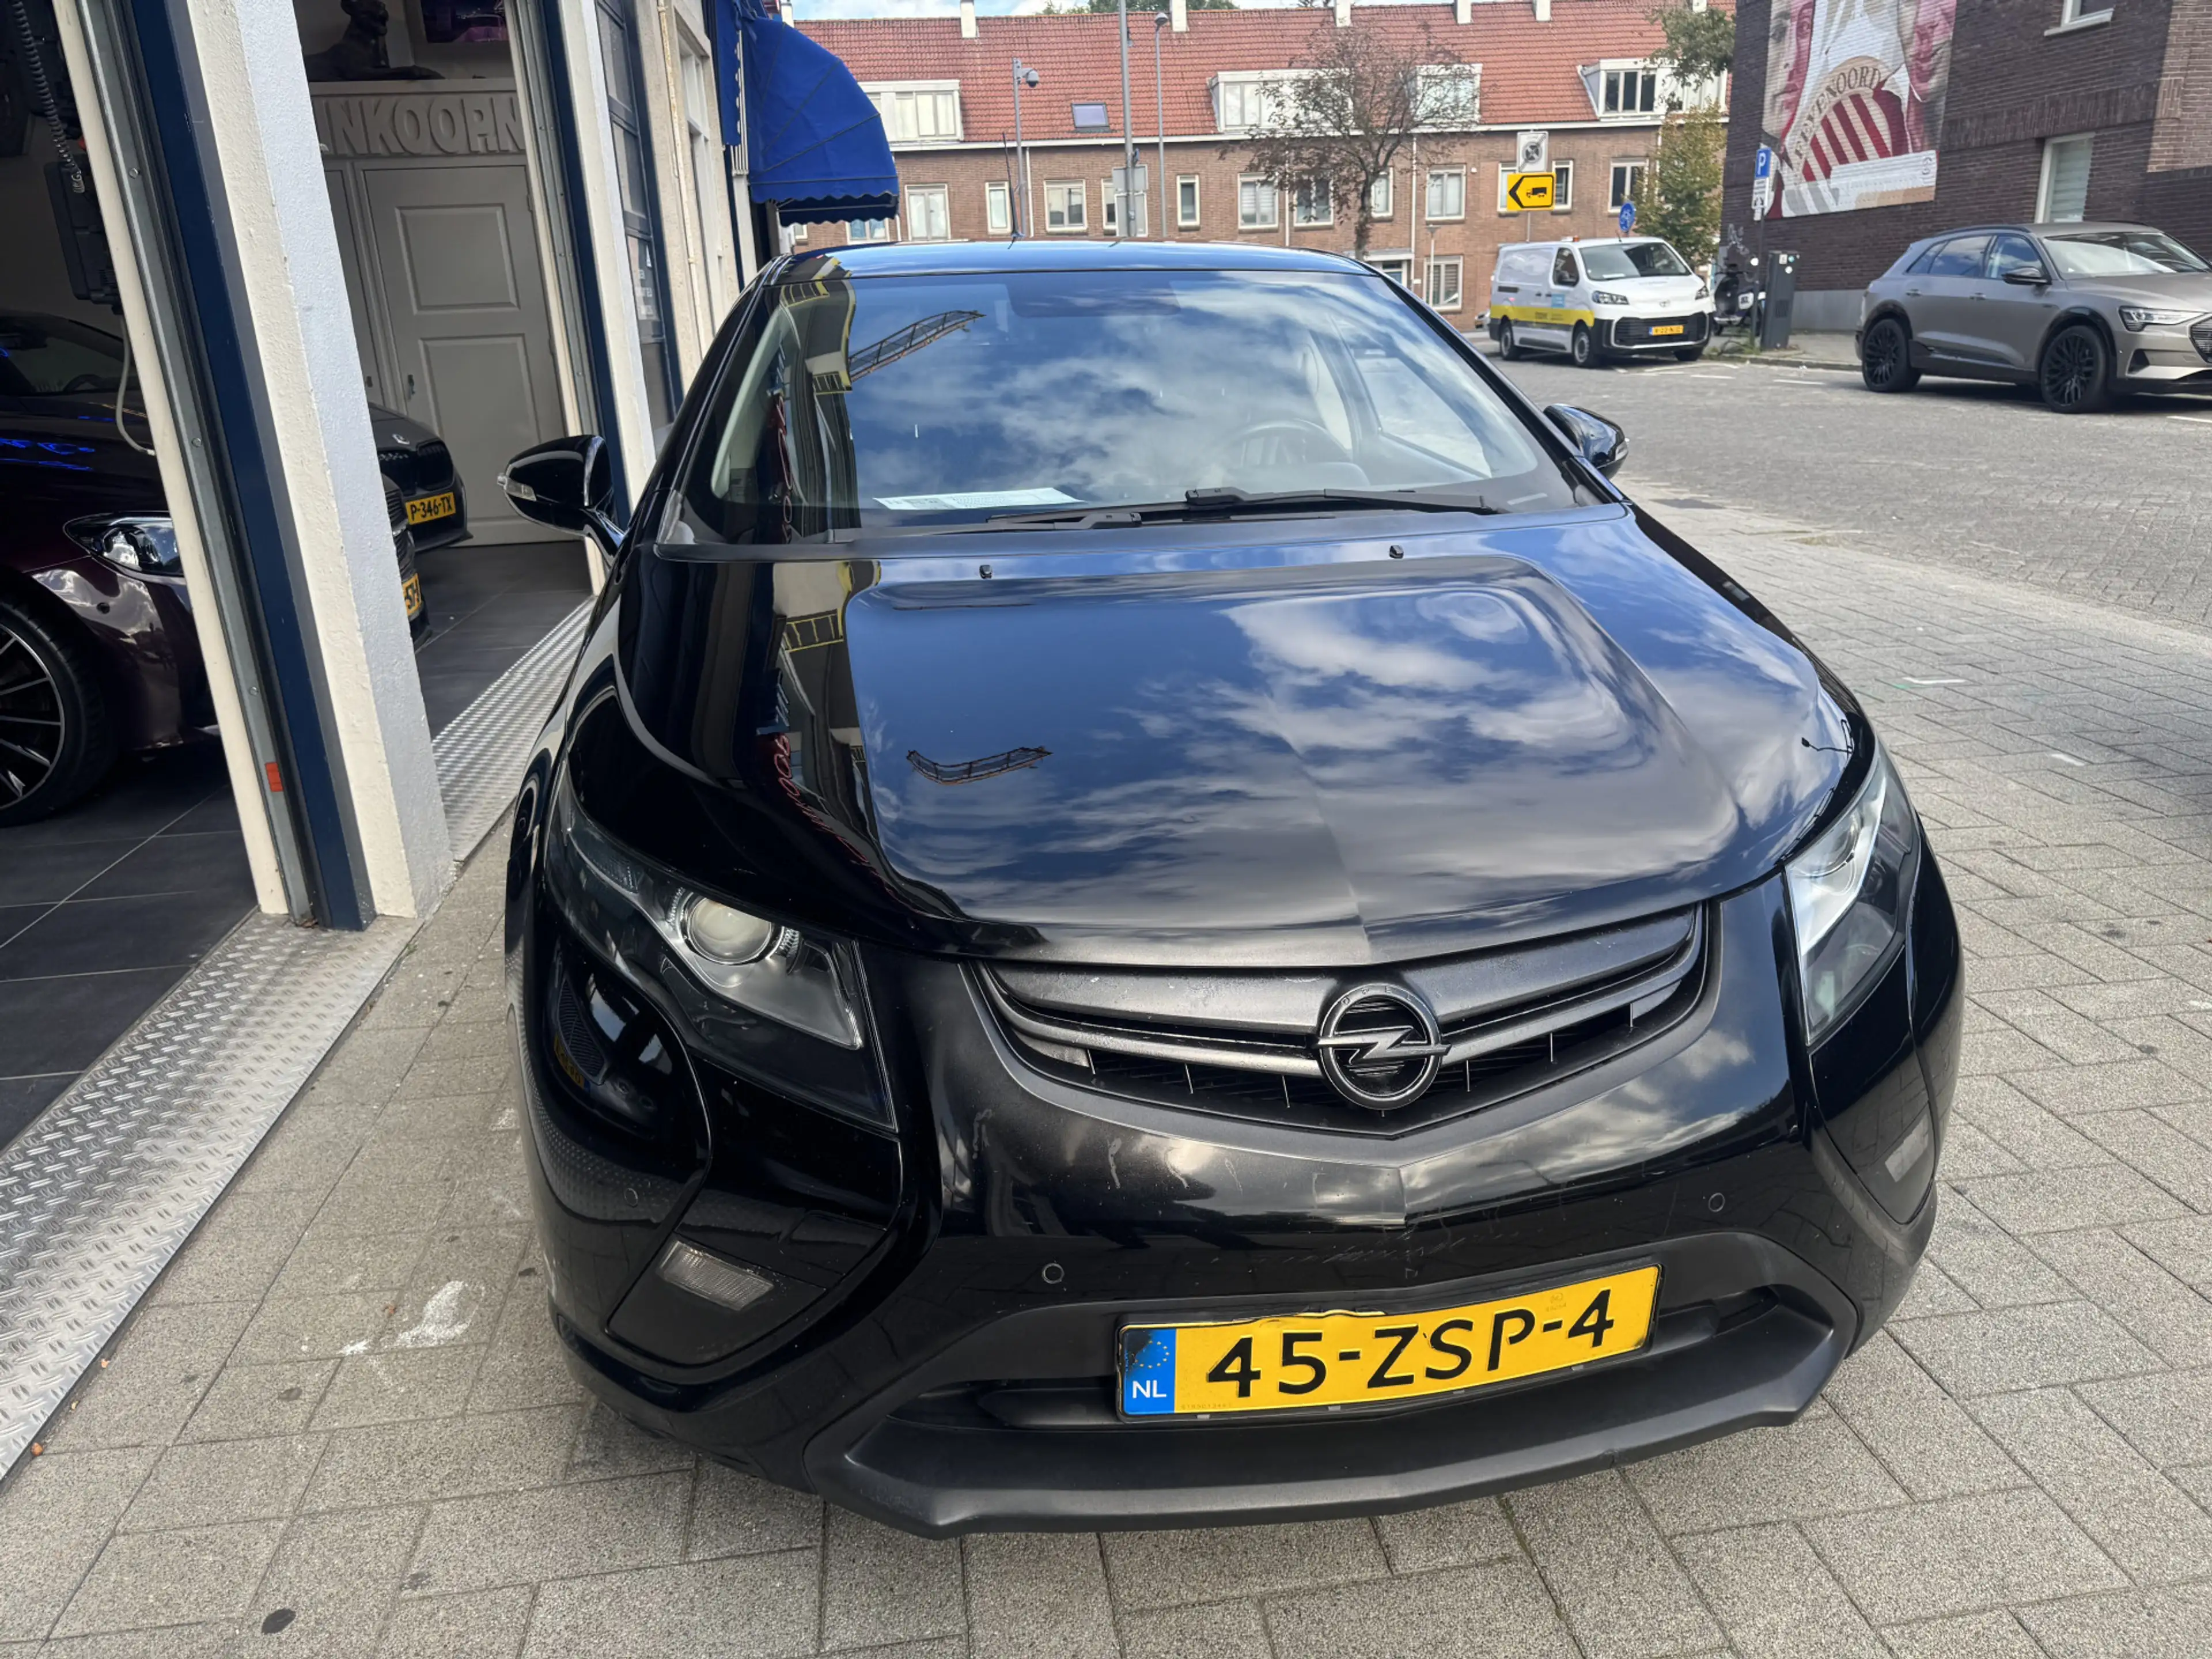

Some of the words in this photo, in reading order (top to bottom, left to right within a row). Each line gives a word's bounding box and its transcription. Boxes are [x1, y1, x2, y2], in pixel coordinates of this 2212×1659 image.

[1757, 152, 1767, 176] P
[410, 495, 453, 521] P-346-TX
[1340, 986, 1412, 1005] OPEL
[1207, 1289, 1615, 1398] 45-ZSP-4
[1132, 1380, 1167, 1399] NL
